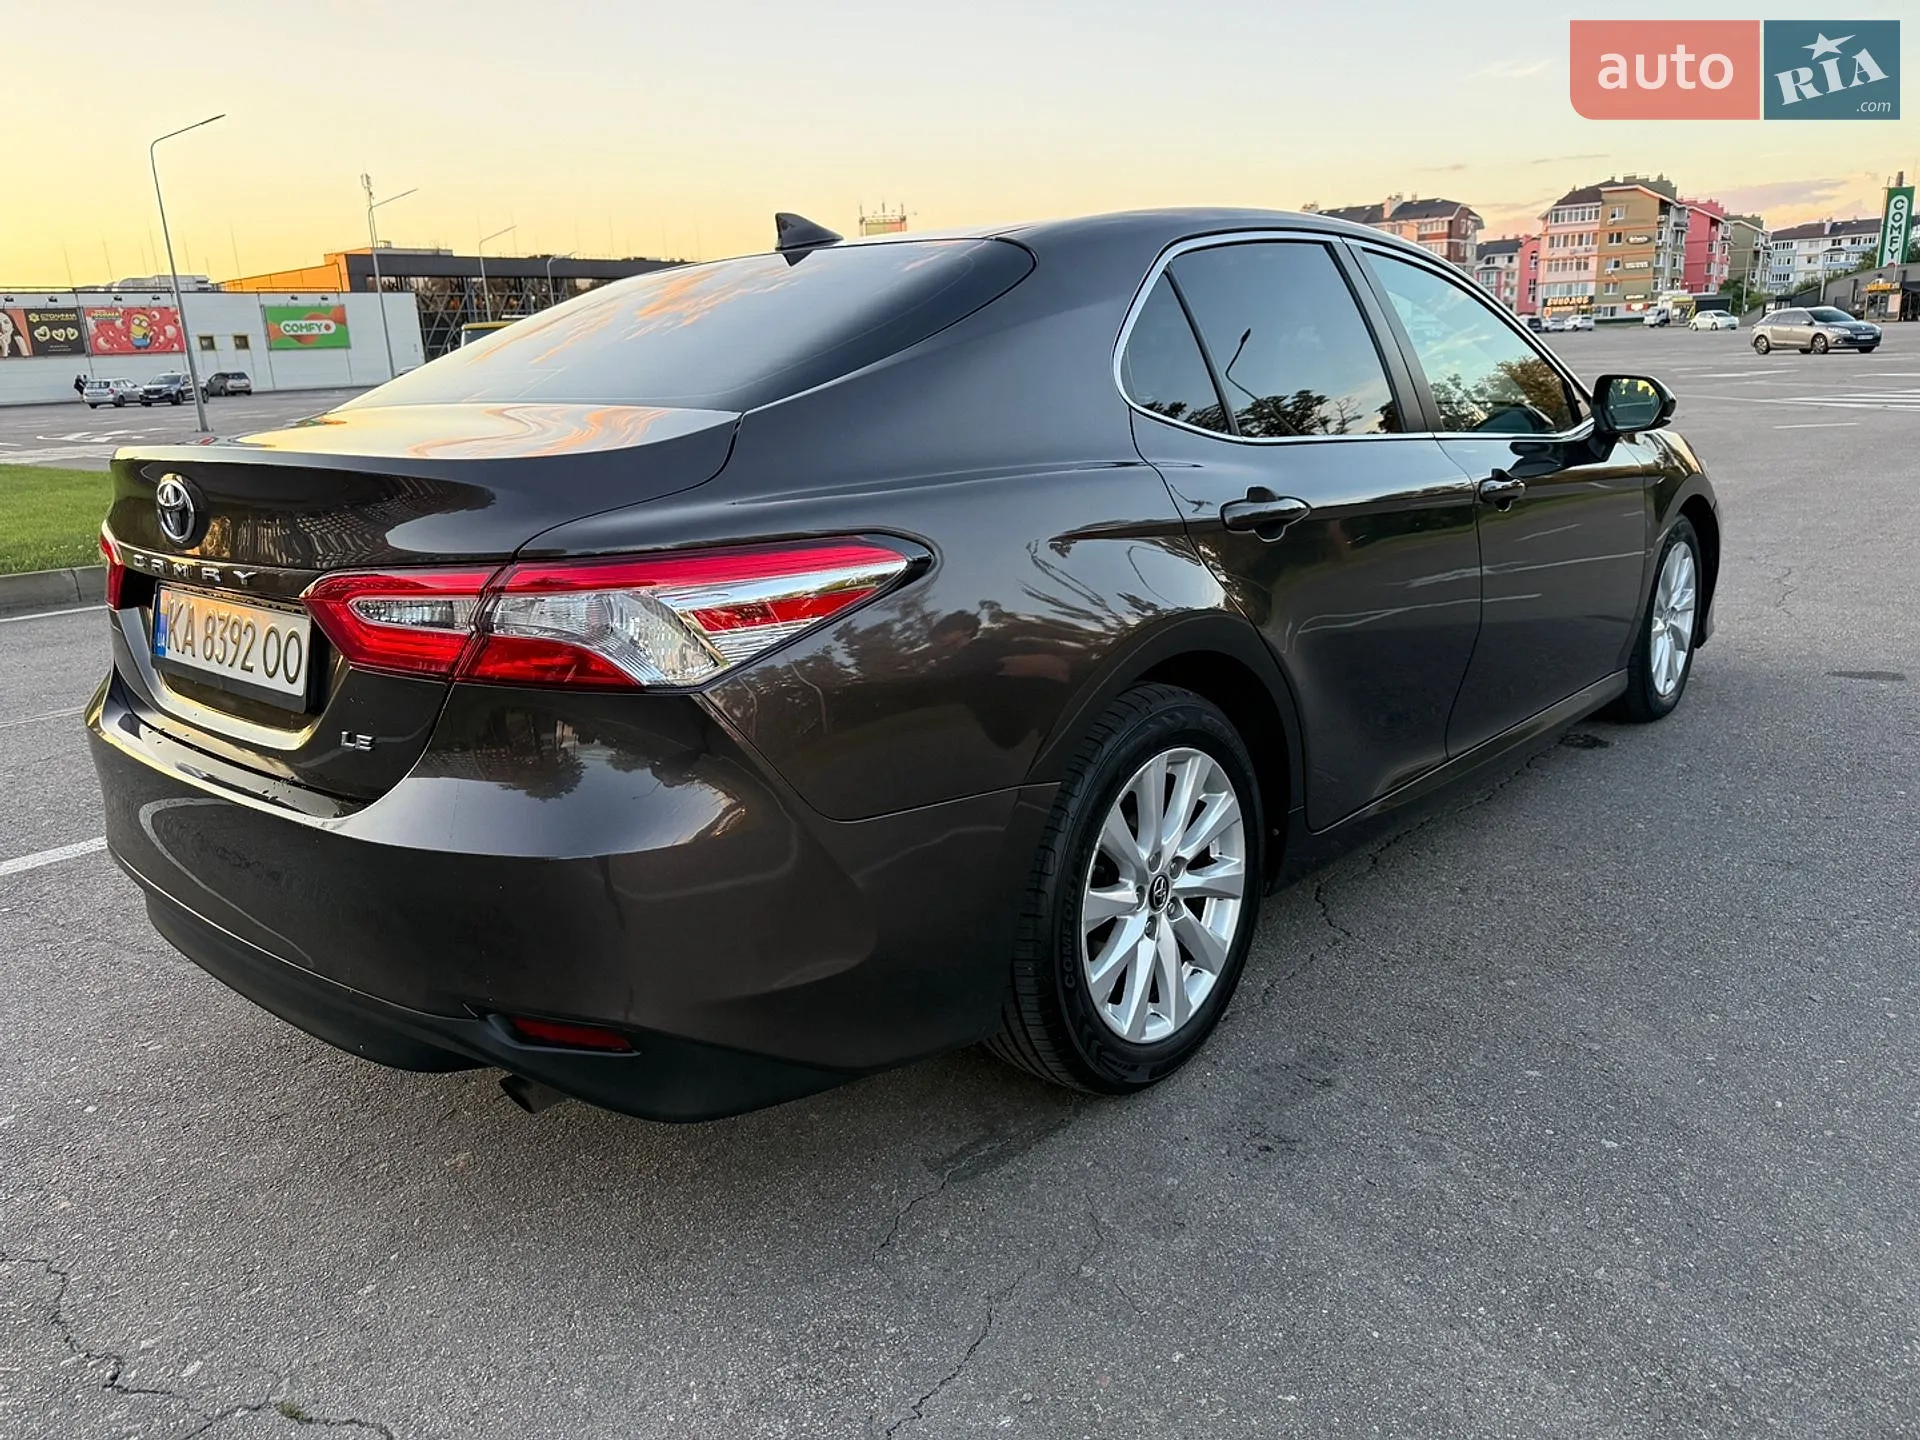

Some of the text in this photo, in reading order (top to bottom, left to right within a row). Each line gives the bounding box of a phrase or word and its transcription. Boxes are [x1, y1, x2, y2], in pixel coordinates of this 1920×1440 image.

[1888, 199, 1904, 259] COMFY
[283, 323, 322, 333] COMFY
[133, 554, 257, 585] CAMRY
[167, 599, 196, 657] KA
[203, 609, 257, 673] 8392
[341, 731, 372, 750] LE
